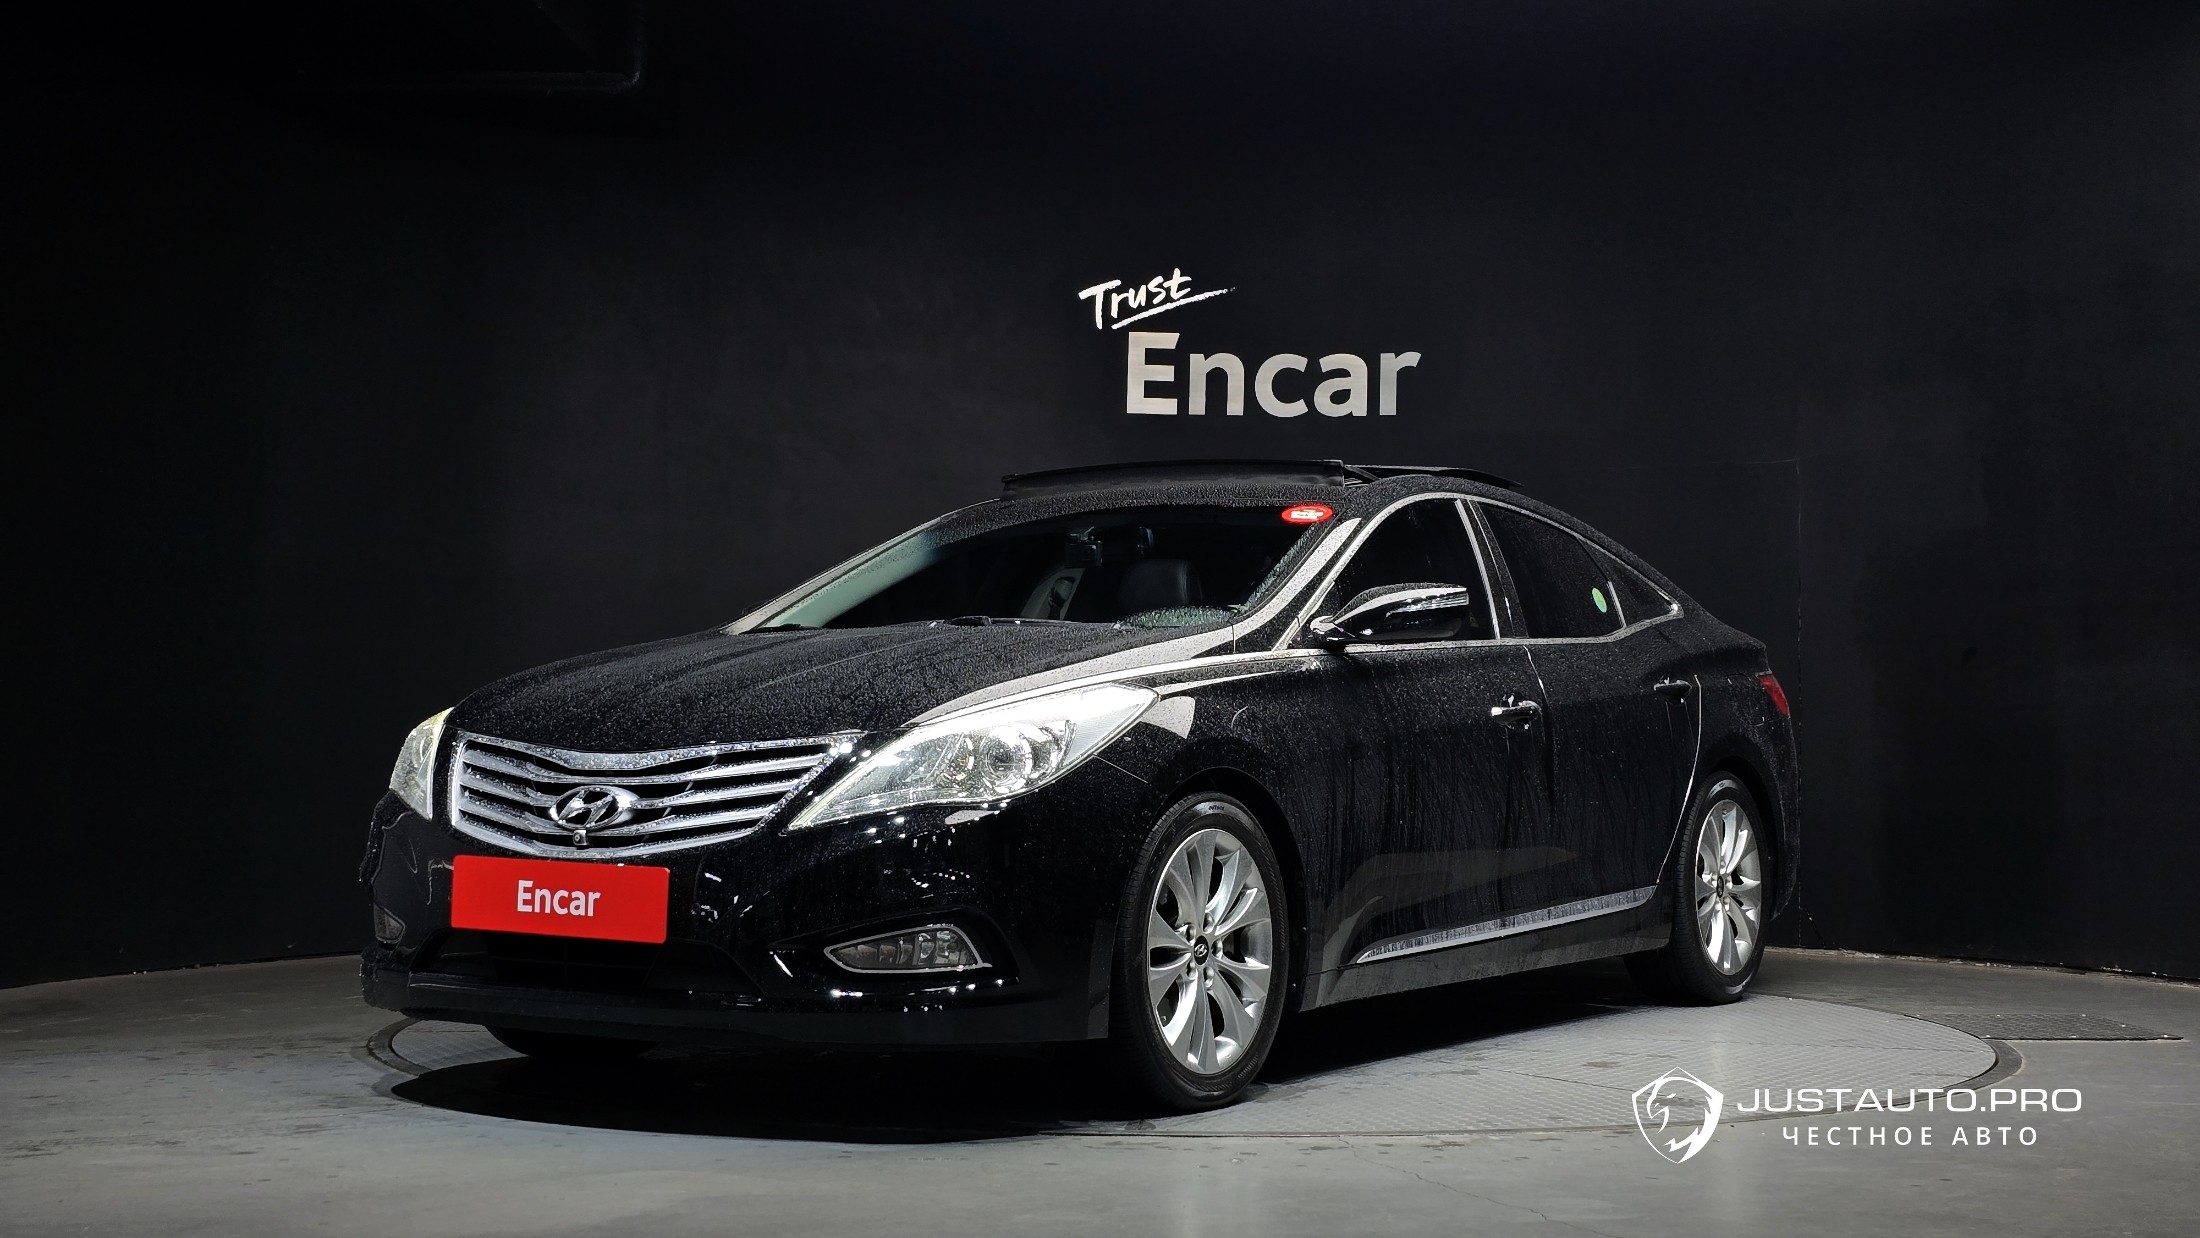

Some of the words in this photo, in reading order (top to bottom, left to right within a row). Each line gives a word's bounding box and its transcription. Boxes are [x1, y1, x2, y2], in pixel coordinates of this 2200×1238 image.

[1078, 268, 1193, 329] Trust
[1126, 331, 1422, 418] Encar
[516, 879, 601, 917] Encar
